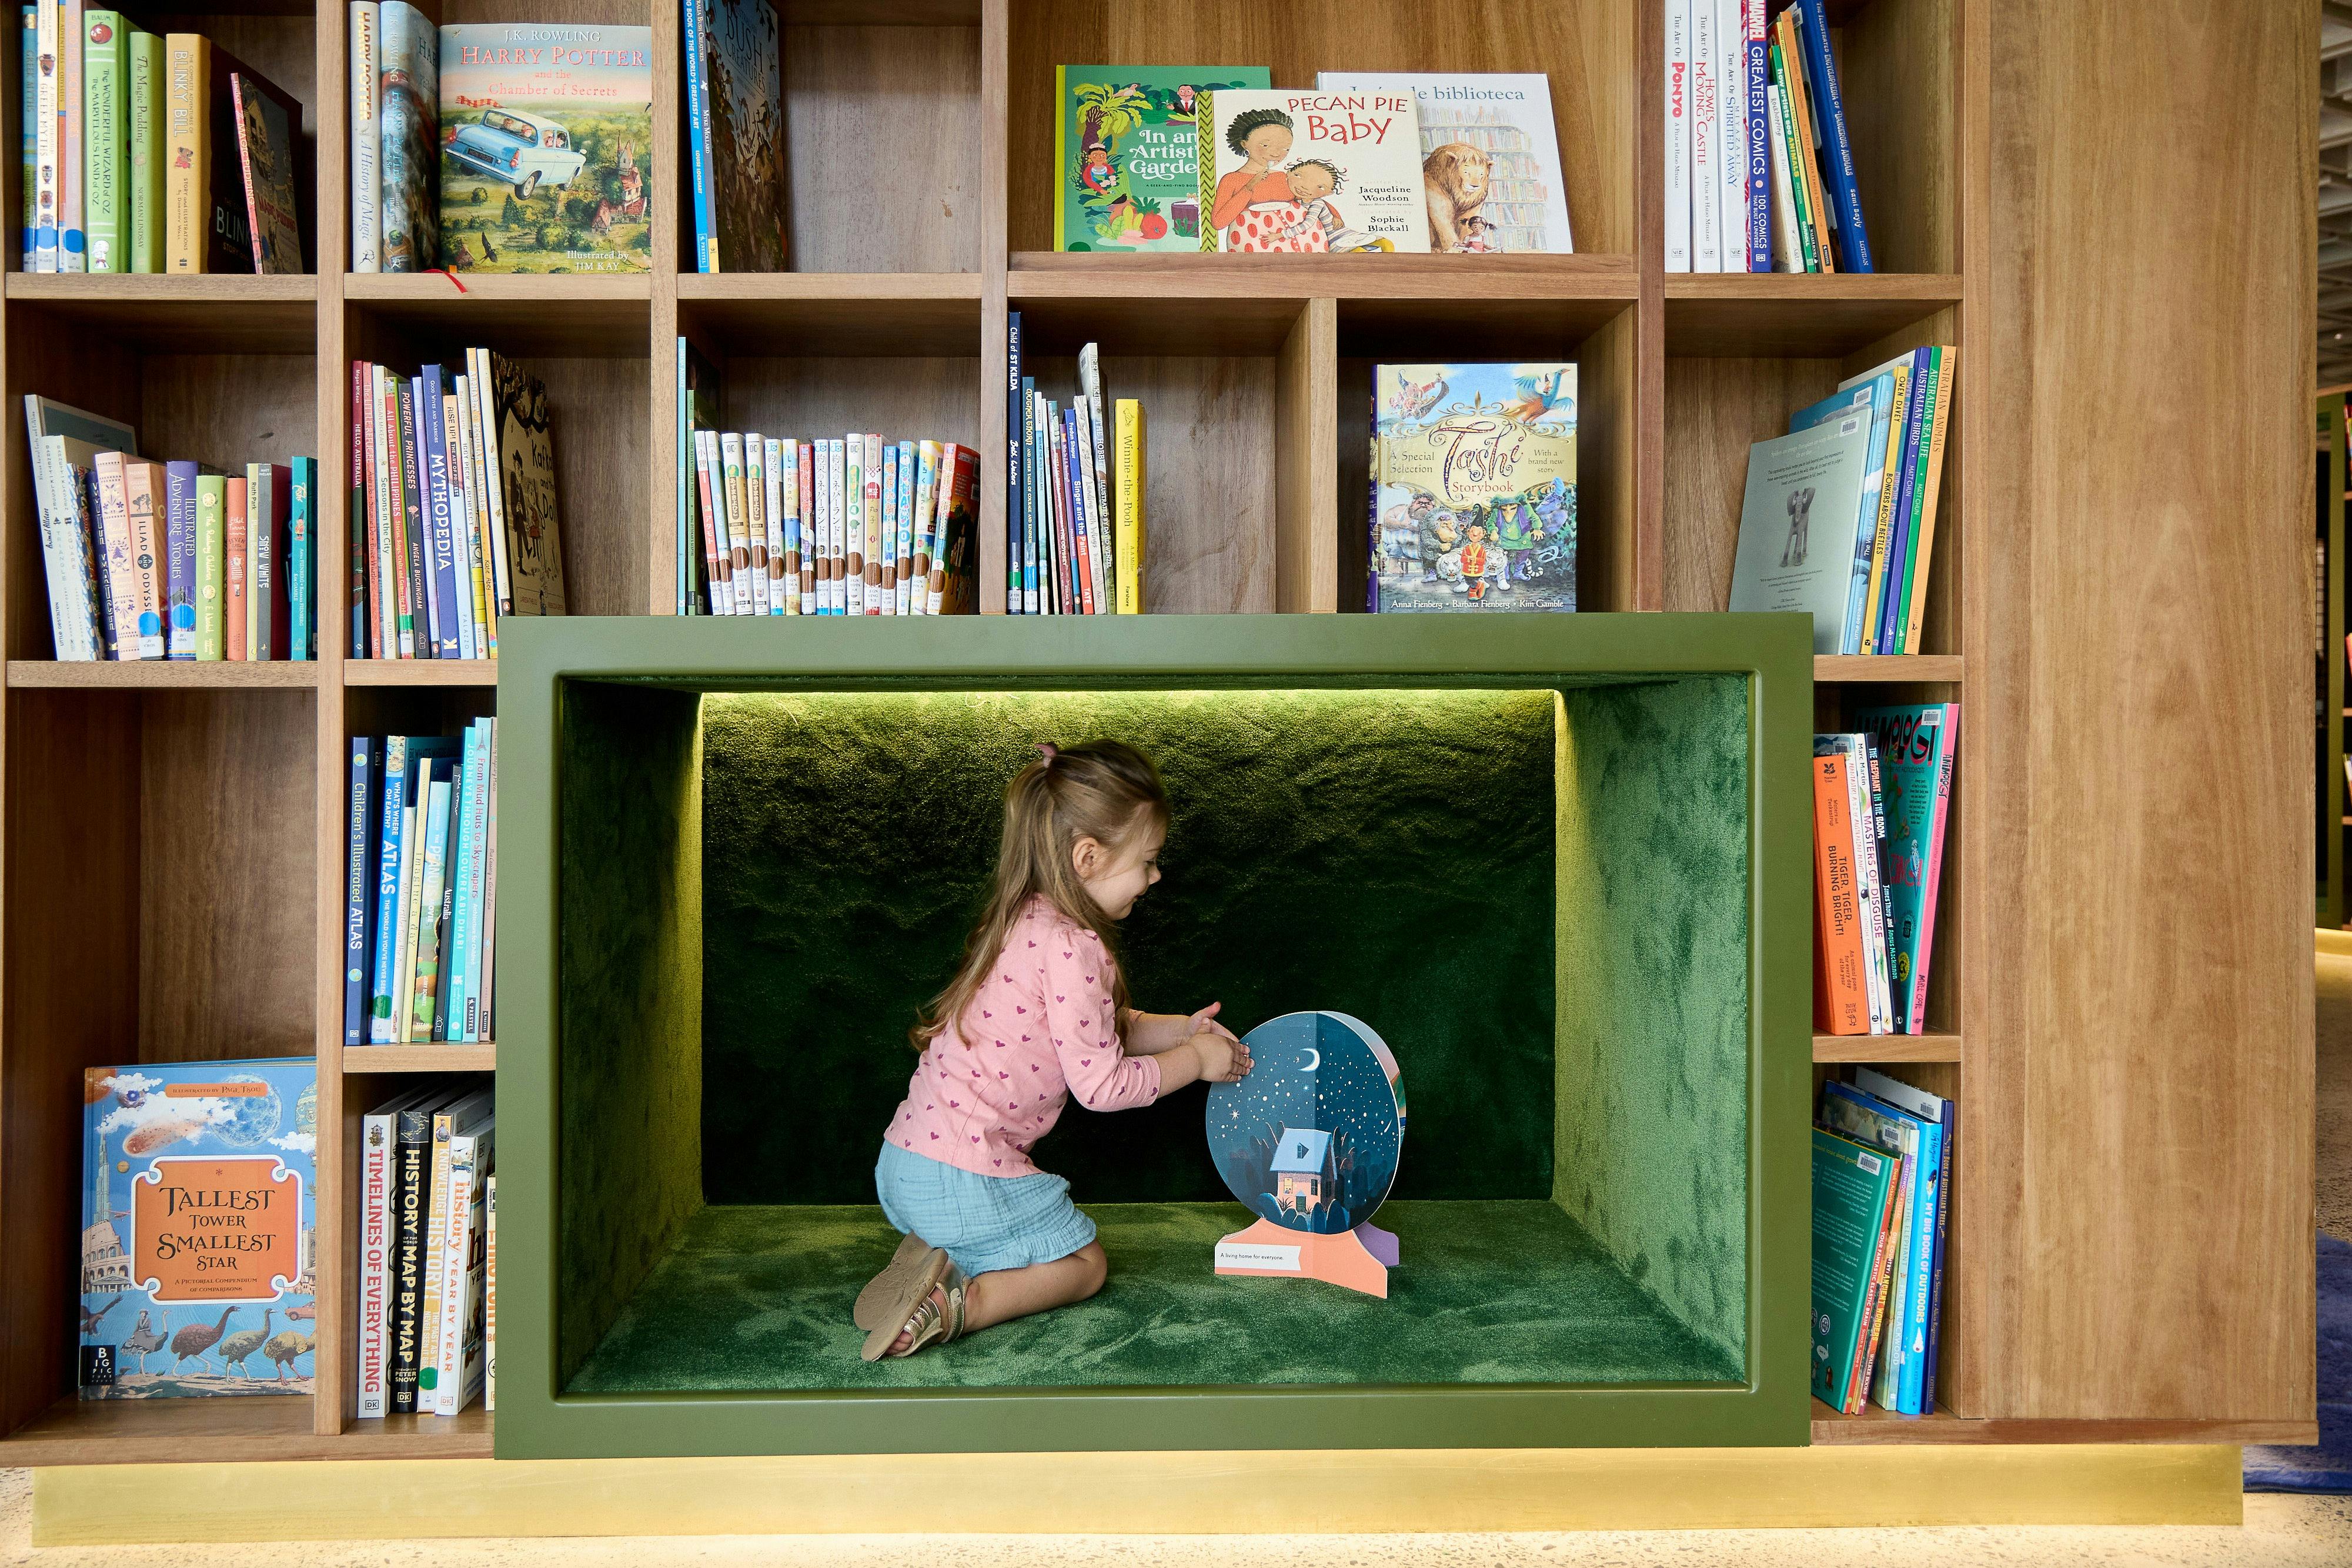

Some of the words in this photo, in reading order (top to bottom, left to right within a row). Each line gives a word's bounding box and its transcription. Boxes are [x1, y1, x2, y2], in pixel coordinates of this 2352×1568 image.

[358, 11, 370, 61] HARRY
[505, 30, 527, 42] J.K.
[531, 31, 601, 42] ROWLING
[136, 56, 148, 71] The
[461, 46, 544, 66] HARRY
[552, 46, 646, 67] POTTER
[1674, 48, 1681, 57] OF
[173, 51, 188, 102] BLINKY
[687, 29, 693, 38] OF
[690, 85, 699, 115] GREATEST
[1752, 46, 1764, 114] GREATEST
[135, 76, 147, 103] Magic
[359, 63, 372, 121] POTTER
[489, 83, 549, 96] Chamber
[553, 83, 567, 95] of
[571, 86, 617, 96] Secrets
[1287, 96, 1365, 112] PECAN
[1375, 97, 1408, 112] PIE
[1434, 86, 1525, 100] biblioteca
[1672, 62, 1685, 118] PONYO
[1695, 62, 1706, 116] MOVING
[1706, 79, 1715, 122] HOWL'S
[1818, 15, 1829, 52] ILLUSTRATED
[1825, 54, 1839, 100] ENCYCLOPAEDIA
[1834, 111, 1848, 148] DANGEROUS
[1841, 149, 1853, 176] ANIMALS
[102, 84, 111, 145] WONDERFUL
[135, 106, 147, 143] Pudding
[173, 108, 188, 138] BILL
[1308, 113, 1392, 145] Baby
[1726, 97, 1737, 150] SPIRITED
[1140, 130, 1167, 144] In
[1172, 132, 1197, 144] an
[1696, 122, 1708, 166] CASTLE
[1752, 118, 1765, 175] COMICS
[102, 148, 111, 188] WIZARD
[1130, 159, 1198, 180] Garde
[1728, 154, 1737, 188] AWAY
[102, 189, 111, 199] of
[102, 200, 111, 214] OZ
[1370, 216, 1405, 224] Sophie
[576, 262, 593, 271] JIM
[596, 262, 620, 271] KAY
[1010, 355, 1017, 365] ST
[1915, 367, 1928, 419] AUSTRALIAN
[1925, 368, 1938, 419] AUSTRALIAN
[1938, 355, 1952, 409] AUSTRALIAN
[402, 392, 412, 436] POWERFUL
[1911, 422, 1923, 445] BIRDS
[1922, 423, 1931, 438] SEA
[1933, 414, 1945, 452] ANIMALS
[405, 440, 416, 489] PRINCESSES
[1097, 438, 1105, 466] HOBBIT
[1429, 420, 1524, 503] Tashi
[1920, 442, 1929, 458] LIFE
[1074, 481, 1082, 505] Singer
[1452, 482, 1514, 495] Storybook
[1883, 473, 1893, 503] BONKERS
[169, 473, 186, 536] ADVENTURE
[432, 454, 452, 570] MYTHOPEDIA
[1880, 504, 1889, 527] ABOUT
[138, 520, 147, 551] ILIAD
[185, 498, 197, 556] ILLUSTRATED
[1876, 529, 1886, 554] BEETLES
[171, 542, 183, 579] STORIES
[259, 536, 270, 559] SNOW
[383, 538, 391, 554] City
[259, 563, 270, 589] WHITE
[1391, 600, 1412, 609] Anna
[1414, 600, 1443, 609] Fienberg
[1452, 600, 1479, 608] Barbara
[1481, 600, 1510, 609] Fienberg
[1519, 600, 1534, 608] Kim
[1536, 600, 1564, 608] Gamble
[477, 758, 485, 780] From
[476, 784, 484, 805] Mud
[353, 783, 366, 839] Children's
[475, 833, 482, 841] to
[1863, 815, 1876, 865] MASTERS
[352, 844, 364, 902] Illustrated
[382, 840, 398, 894] ATLAS
[471, 845, 482, 898] Skyscrapers
[1828, 845, 1839, 891] BURNING
[1839, 857, 1848, 888] TIGER,
[1869, 870, 1877, 884] OF
[442, 887, 453, 920] Australia
[1832, 895, 1844, 935] BRIGHT!
[1871, 888, 1883, 938] DISGUISE
[350, 907, 363, 950] ATLAS
[159, 1187, 275, 1216] TALLEST
[368, 1149, 383, 1246] TIMELINES
[404, 1149, 420, 1233] HISTORY
[189, 1214, 246, 1229] TOWER
[448, 1181, 470, 1252] history
[1925, 1202, 1933, 1215] MY
[1923, 1218, 1932, 1232] BIG
[157, 1233, 276, 1260] SMALLEST
[368, 1249, 383, 1272] OF
[1921, 1234, 1931, 1259] BOOK
[197, 1256, 238, 1271] STAR
[402, 1246, 417, 1288] MAP
[449, 1259, 459, 1299] YEAR
[1920, 1261, 1929, 1272] OF
[401, 1292, 416, 1316] BY
[1916, 1274, 1927, 1323] OUTDOORS
[447, 1305, 456, 1325] BY
[365, 1276, 382, 1392] EVERYTHING
[399, 1320, 415, 1362] MAP
[445, 1332, 455, 1372] YEAR
